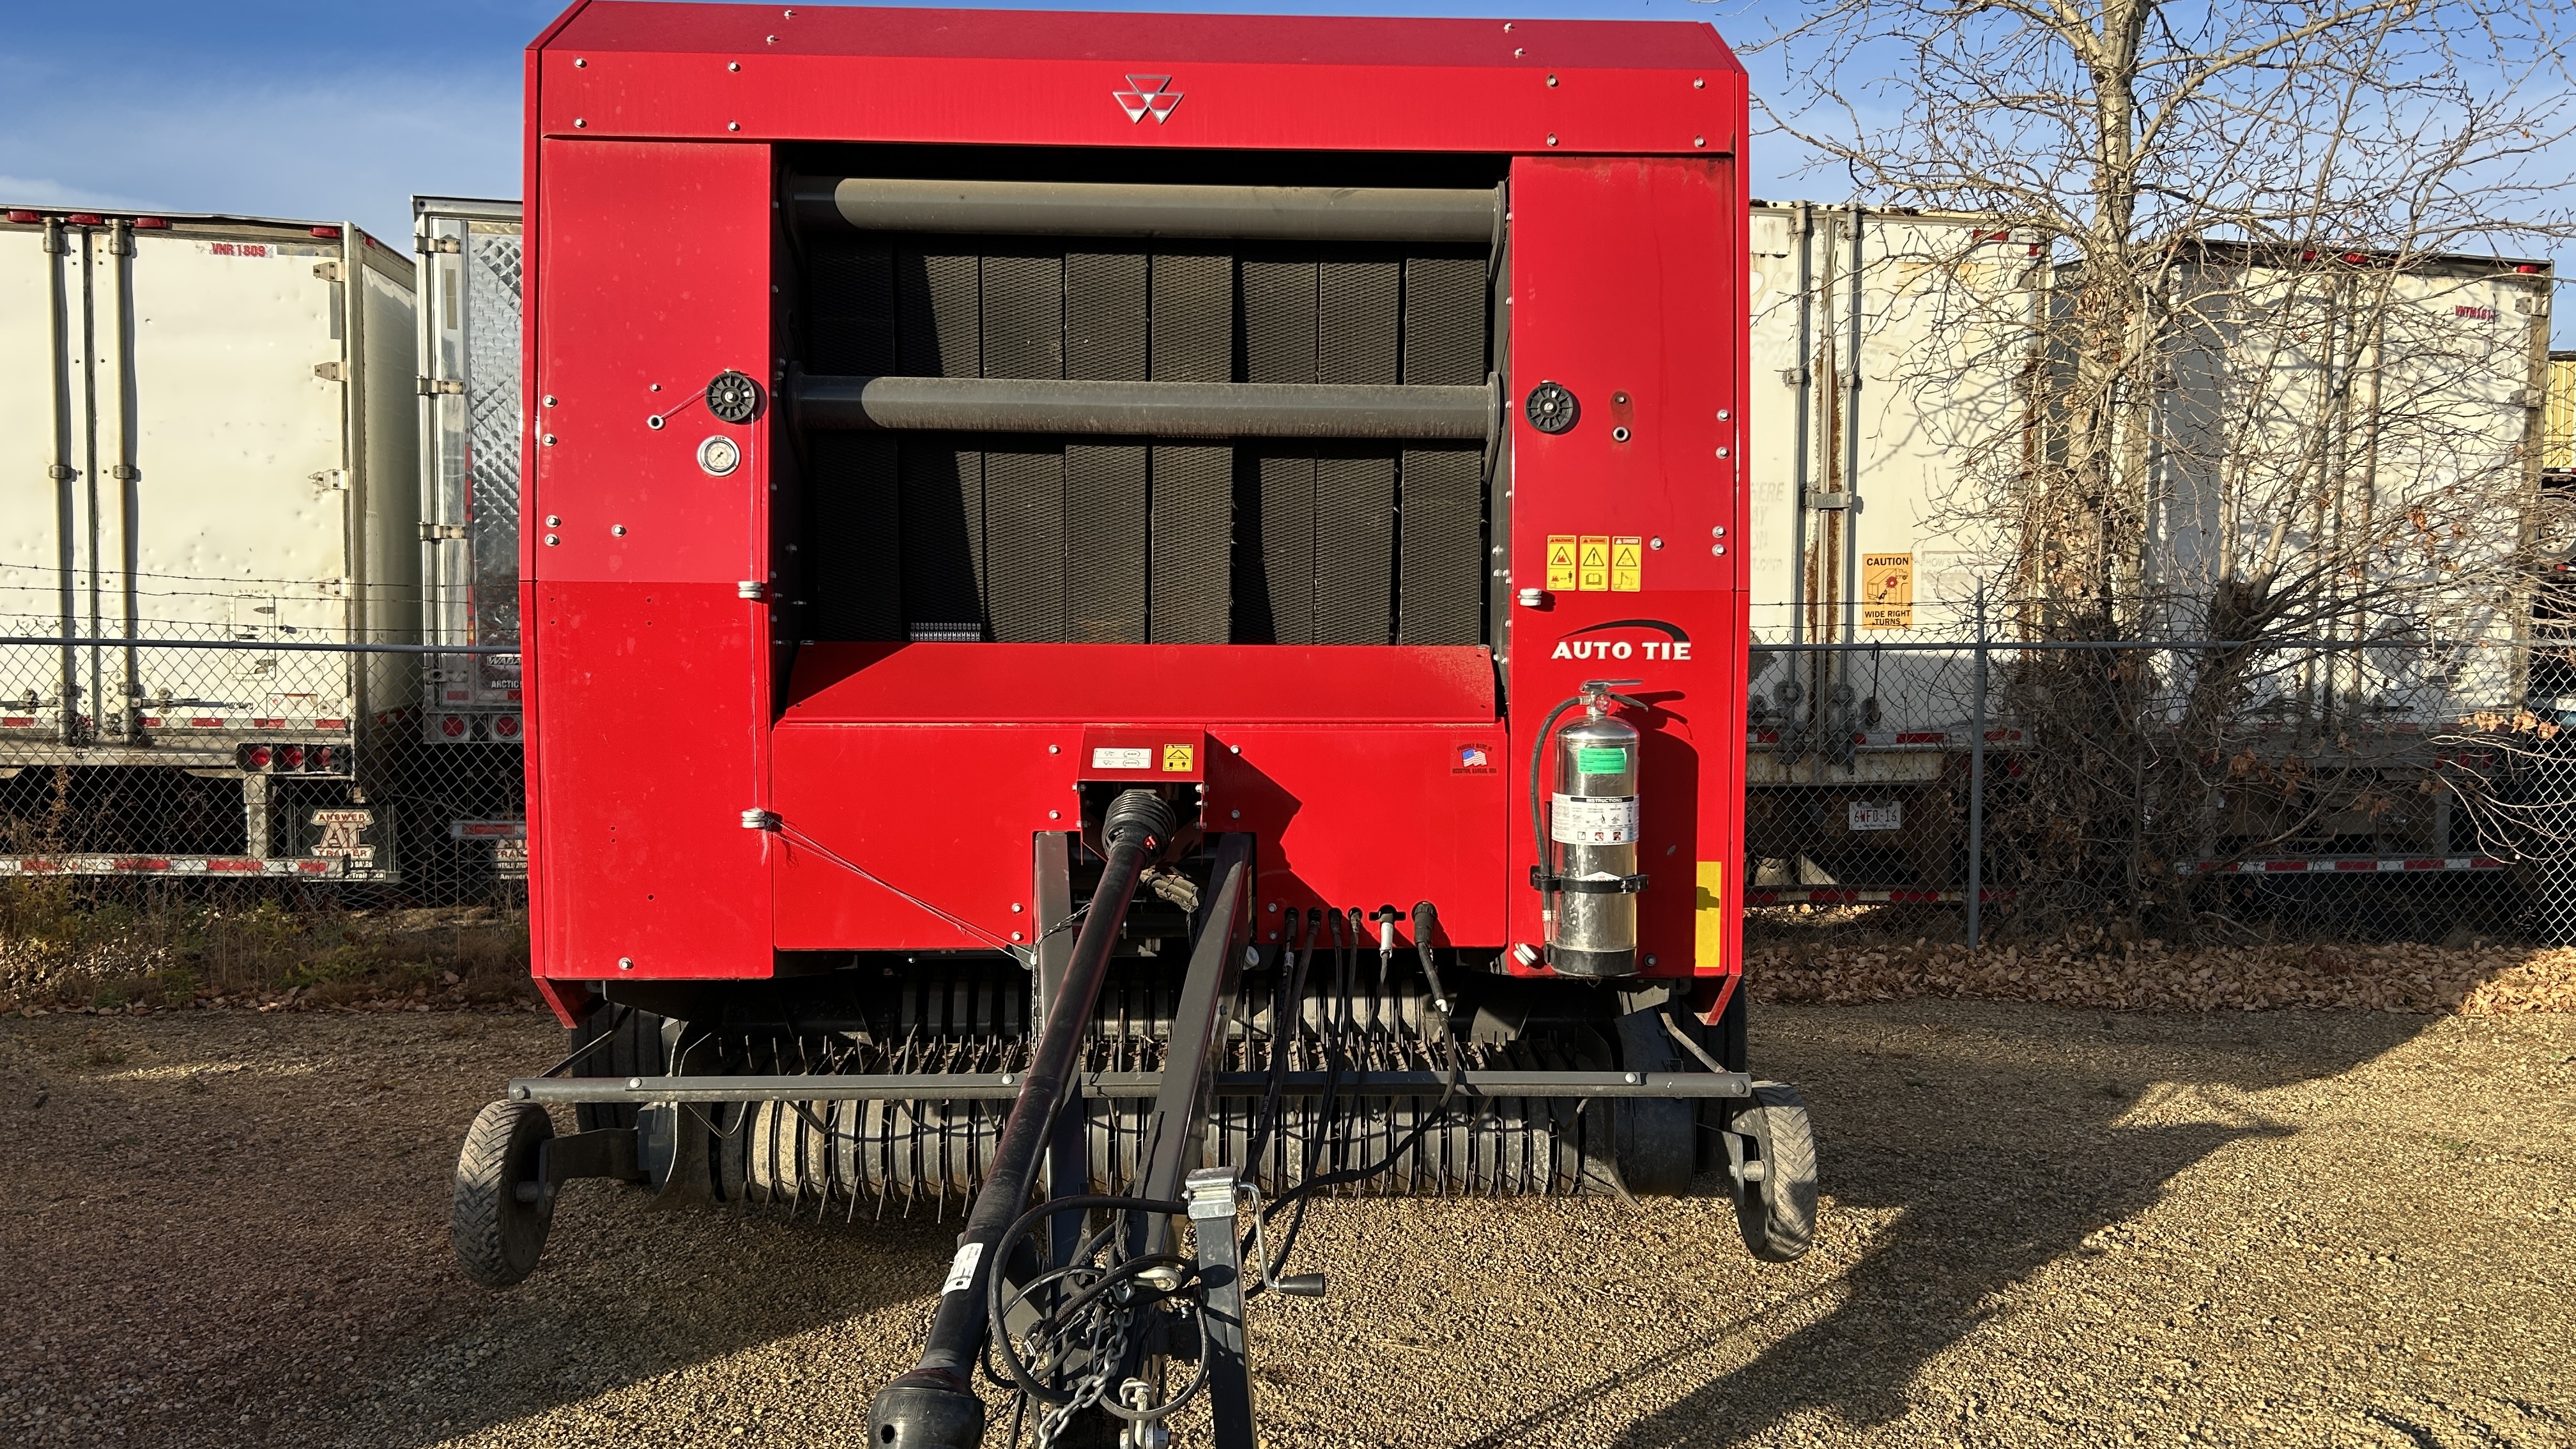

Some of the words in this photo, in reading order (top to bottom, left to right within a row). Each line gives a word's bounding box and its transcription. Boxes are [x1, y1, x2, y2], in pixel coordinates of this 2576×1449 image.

[237, 245, 266, 257] 1809
[1866, 557, 1909, 566] CAUTION
[1551, 641, 1632, 659] AUTO
[1642, 642, 1692, 660] TIE
[487, 656, 521, 665] WABA
[319, 821, 367, 848] AT
